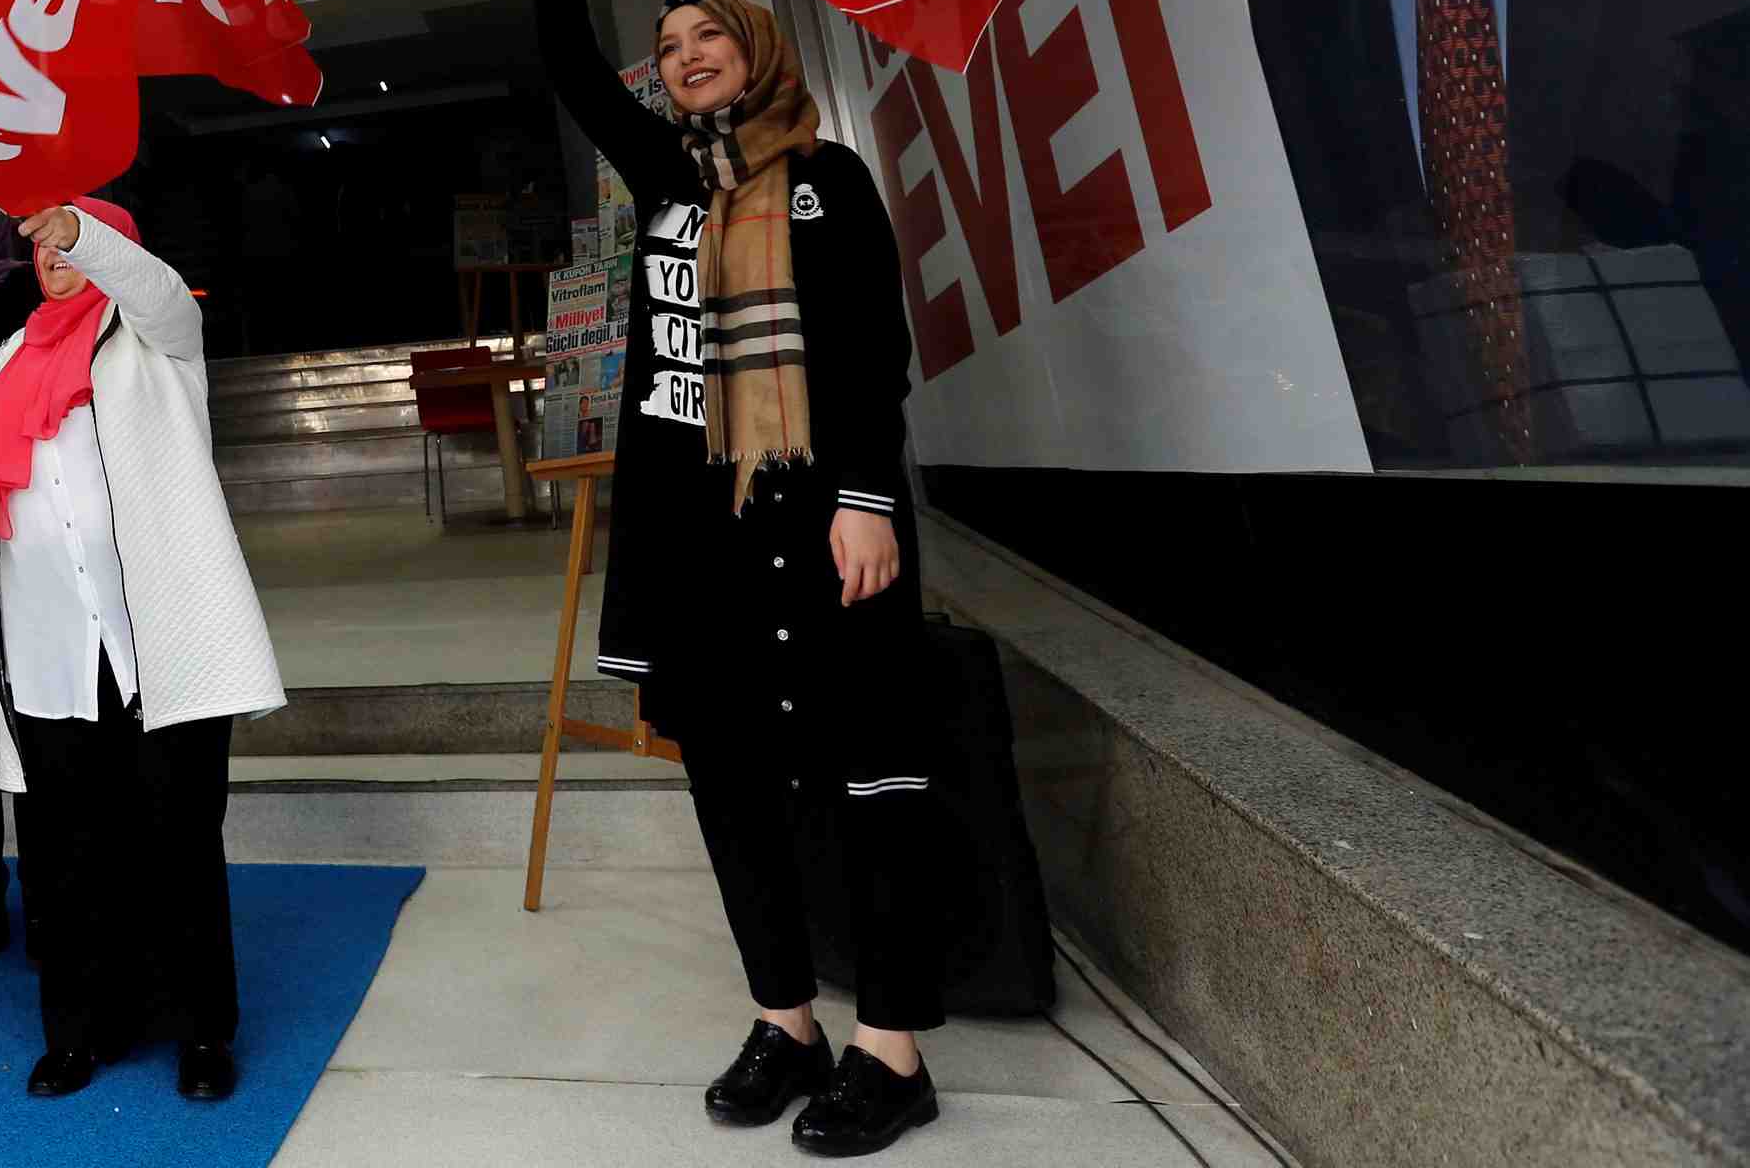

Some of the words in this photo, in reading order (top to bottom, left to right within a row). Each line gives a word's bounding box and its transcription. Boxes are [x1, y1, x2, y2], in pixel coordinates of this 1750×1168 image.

[659, 260, 699, 303] YO
[555, 305, 605, 329] Milliyet
[666, 315, 702, 359] CIT
[670, 374, 706, 419] GIR
